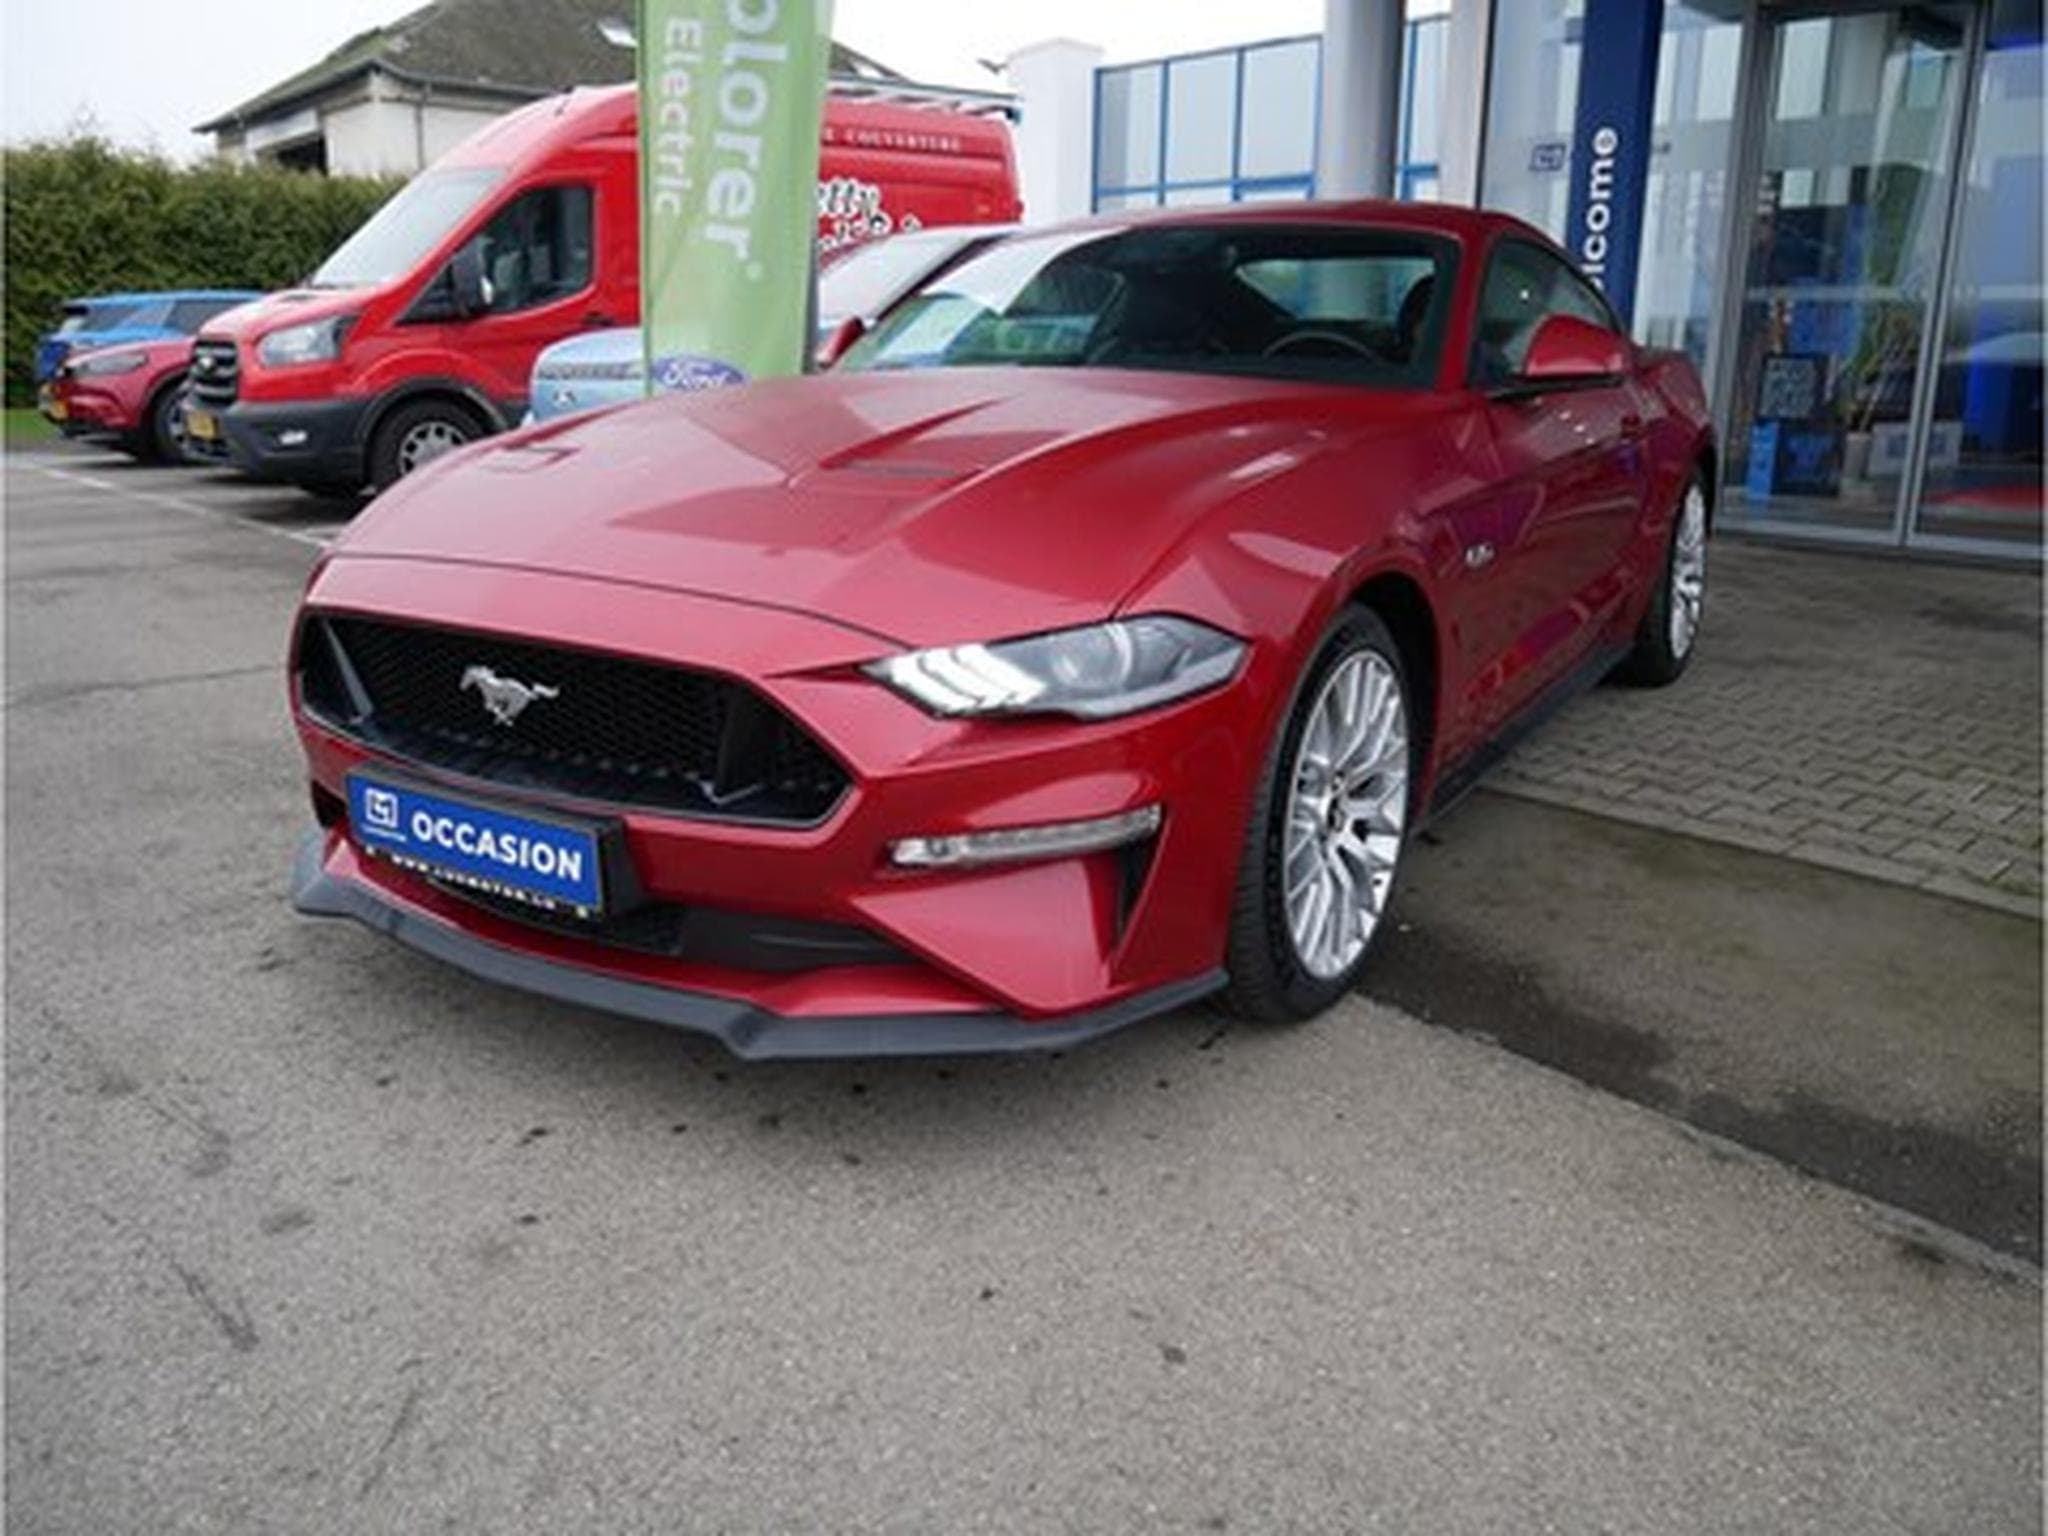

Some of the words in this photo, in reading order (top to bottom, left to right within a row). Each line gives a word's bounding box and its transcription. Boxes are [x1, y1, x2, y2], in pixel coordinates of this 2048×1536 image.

[656, 18, 702, 216] Electric
[663, 361, 729, 391] Ford
[411, 810, 582, 882] OCCASION
